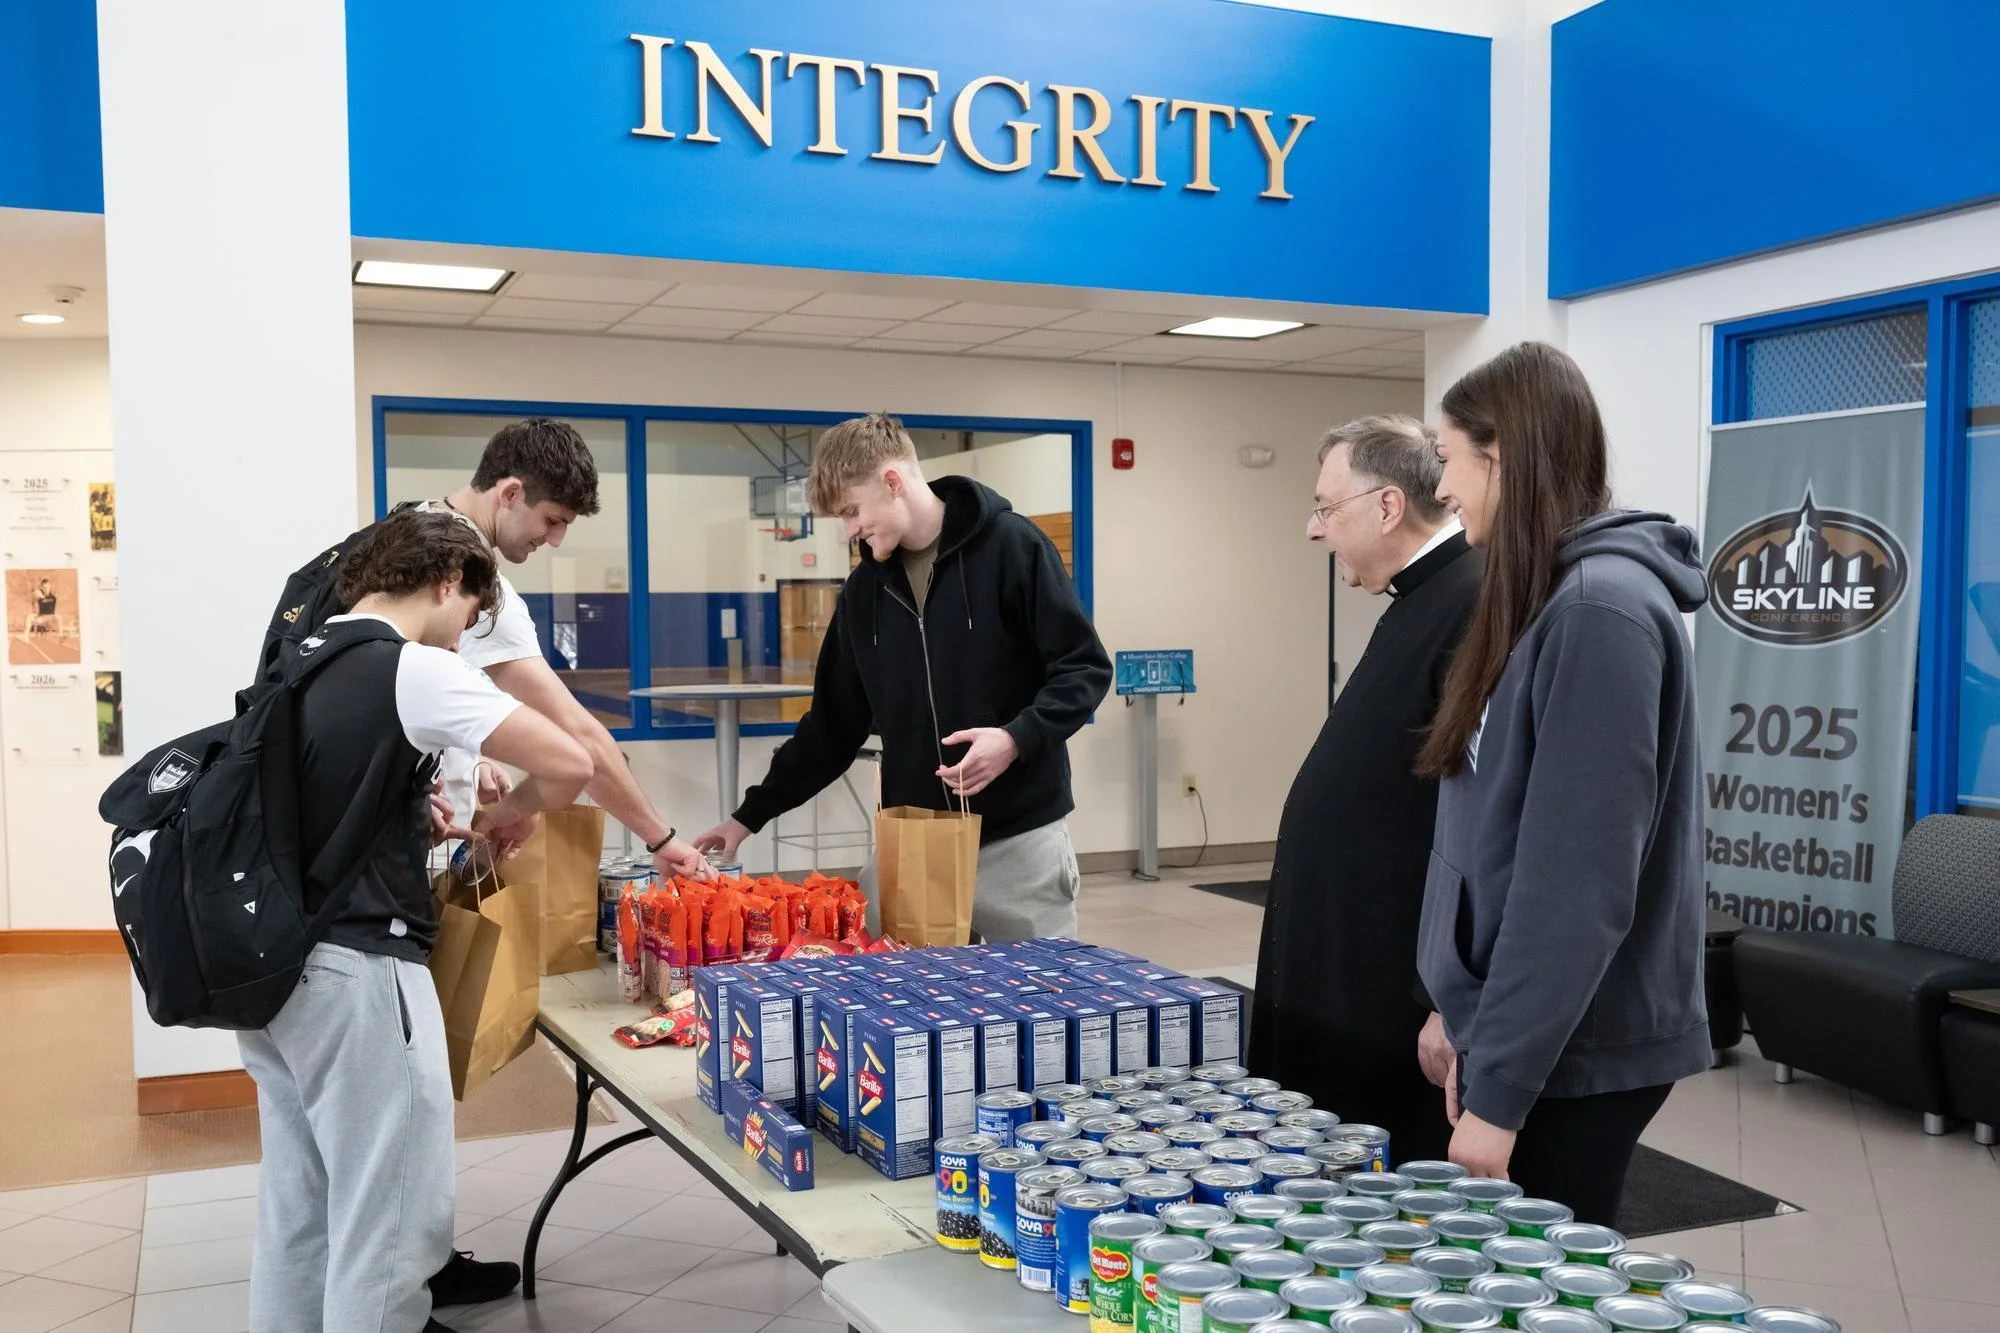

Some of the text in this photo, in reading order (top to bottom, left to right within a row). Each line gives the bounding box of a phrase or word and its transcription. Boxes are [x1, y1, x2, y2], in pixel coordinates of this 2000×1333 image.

[629, 33, 1316, 201] INTEGRITY
[23, 478, 49, 489] 2025
[1732, 586, 1876, 611] SKYLINE
[1750, 612, 1851, 623] CONFERENCE
[31, 675, 56, 686] 2026
[1726, 703, 1858, 761] 2025
[1706, 772, 1869, 824] Women's
[1706, 881, 1877, 937] hampions
[733, 1040, 751, 1059] Barilla
[818, 1051, 837, 1071] Barilla
[860, 1075, 882, 1096] Barilla
[746, 1123, 763, 1147] Barilla
[940, 1155, 967, 1168] GOYA
[940, 1168, 968, 1195] 90
[1101, 1257, 1128, 1271] Monte
[1096, 1296, 1121, 1312] WHOLE
[1111, 1311, 1134, 1322] CORN
